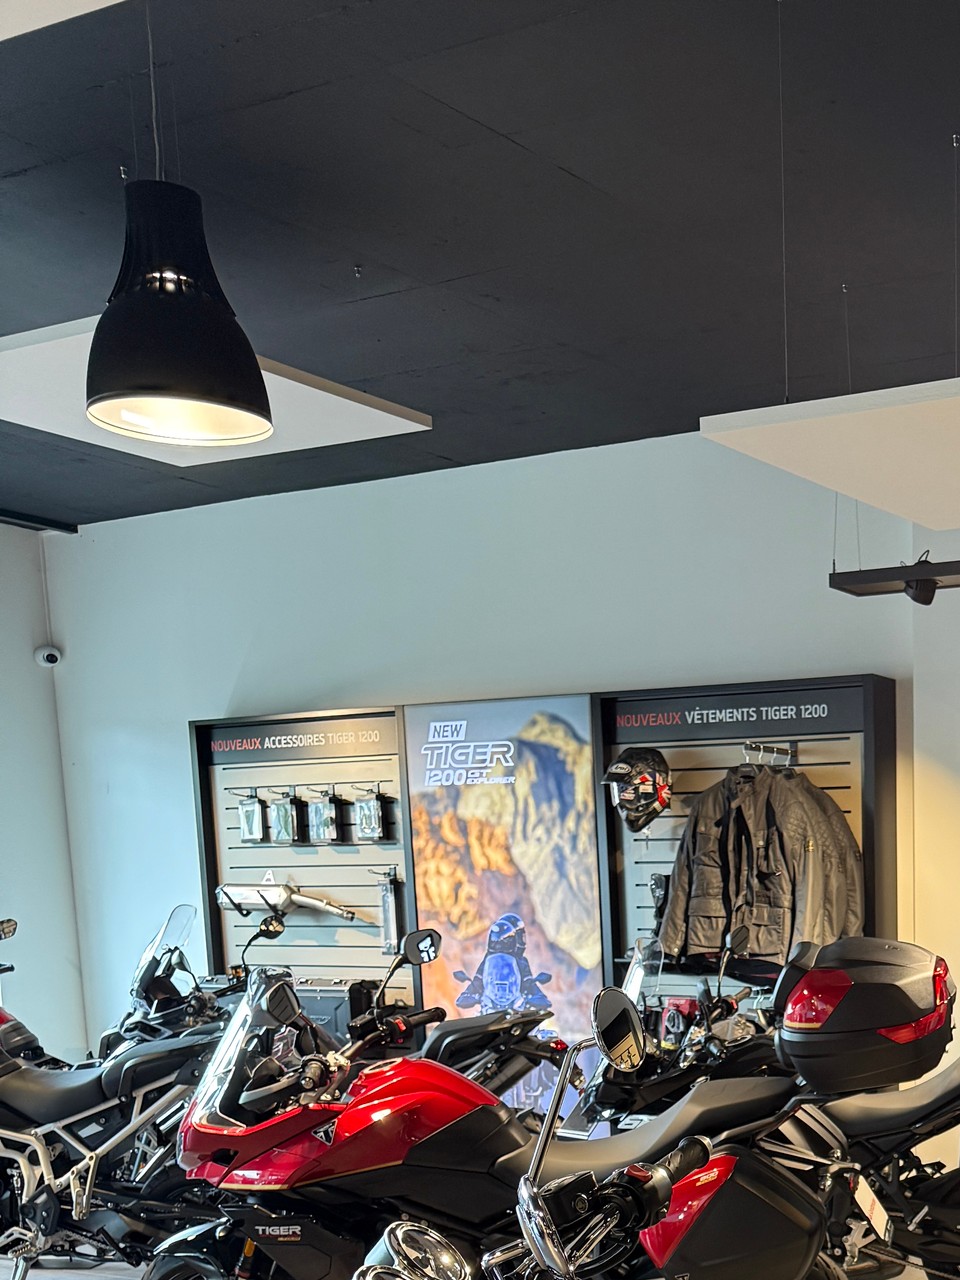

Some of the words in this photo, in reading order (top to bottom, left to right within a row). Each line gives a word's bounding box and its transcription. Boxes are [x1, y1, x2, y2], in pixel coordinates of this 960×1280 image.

[616, 712, 681, 728] NOUVEAUX
[685, 706, 757, 725] VÊTEMENTS
[760, 705, 796, 721] TIGER
[800, 704, 828, 719] 1200
[432, 724, 462, 739] NEW
[211, 738, 261, 752] NOUVEAUX
[264, 733, 325, 749] ACCESSOIRES
[327, 731, 356, 745] TIGER
[358, 730, 380, 743] 1200
[421, 741, 514, 769] TIGER
[425, 769, 467, 786] 1200
[467, 769, 492, 778] GT
[466, 776, 516, 785] EXPLORER
[254, 1225, 302, 1236] TIGER
